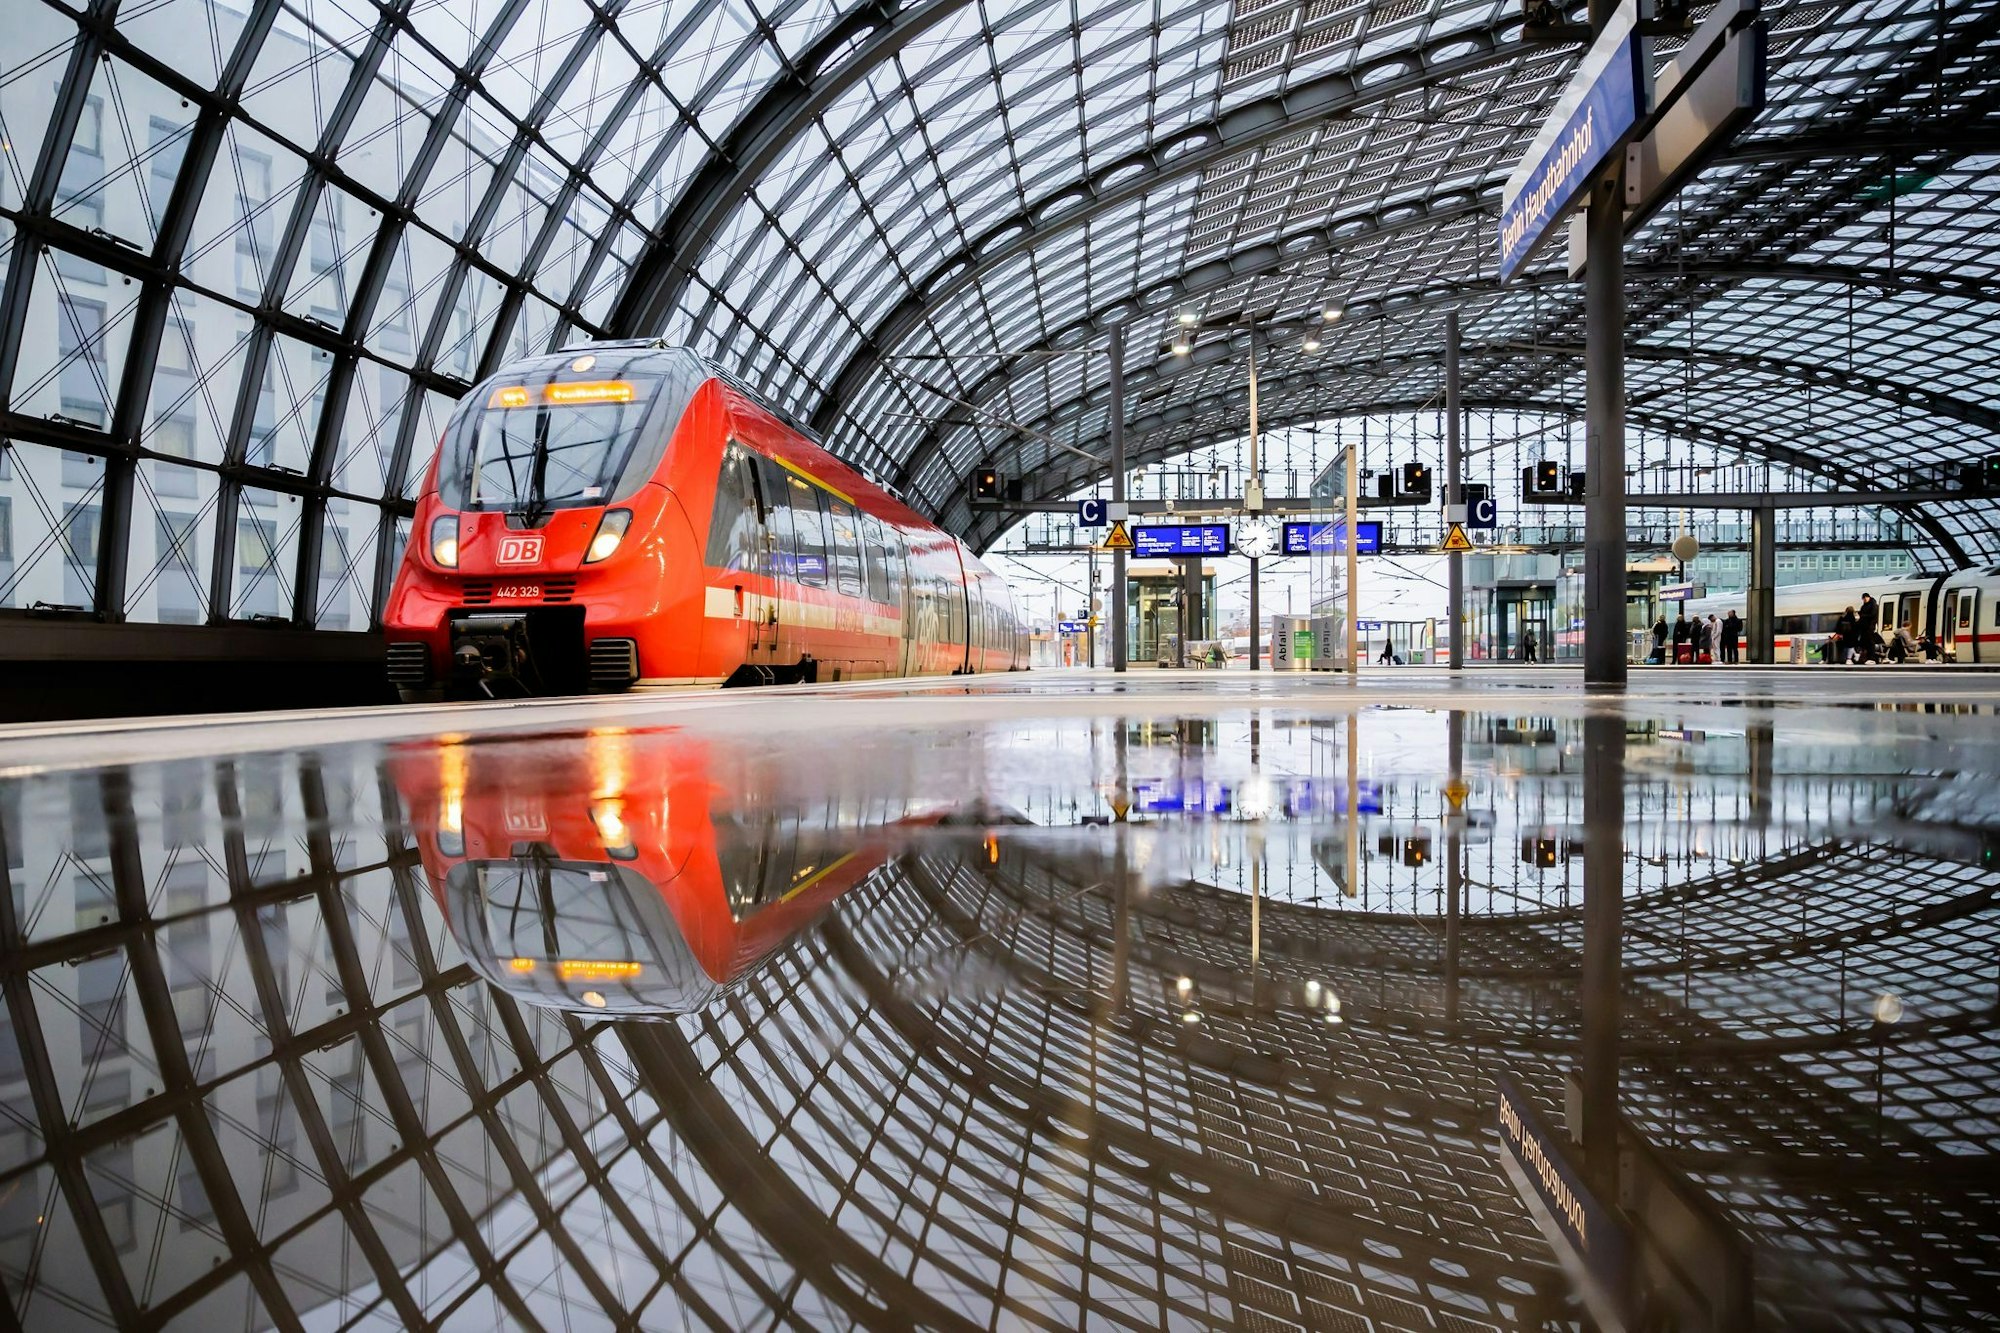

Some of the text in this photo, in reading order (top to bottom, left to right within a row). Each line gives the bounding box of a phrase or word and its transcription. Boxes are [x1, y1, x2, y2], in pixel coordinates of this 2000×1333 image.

[1502, 105, 1593, 260] Berlin Hauptbahnhof
[1082, 501, 1098, 522] C
[1476, 500, 1493, 522] C
[503, 541, 538, 560] DB
[497, 586, 539, 598] 442 329
[1079, 610, 1085, 618] B
[1279, 630, 1287, 661] Abfall
